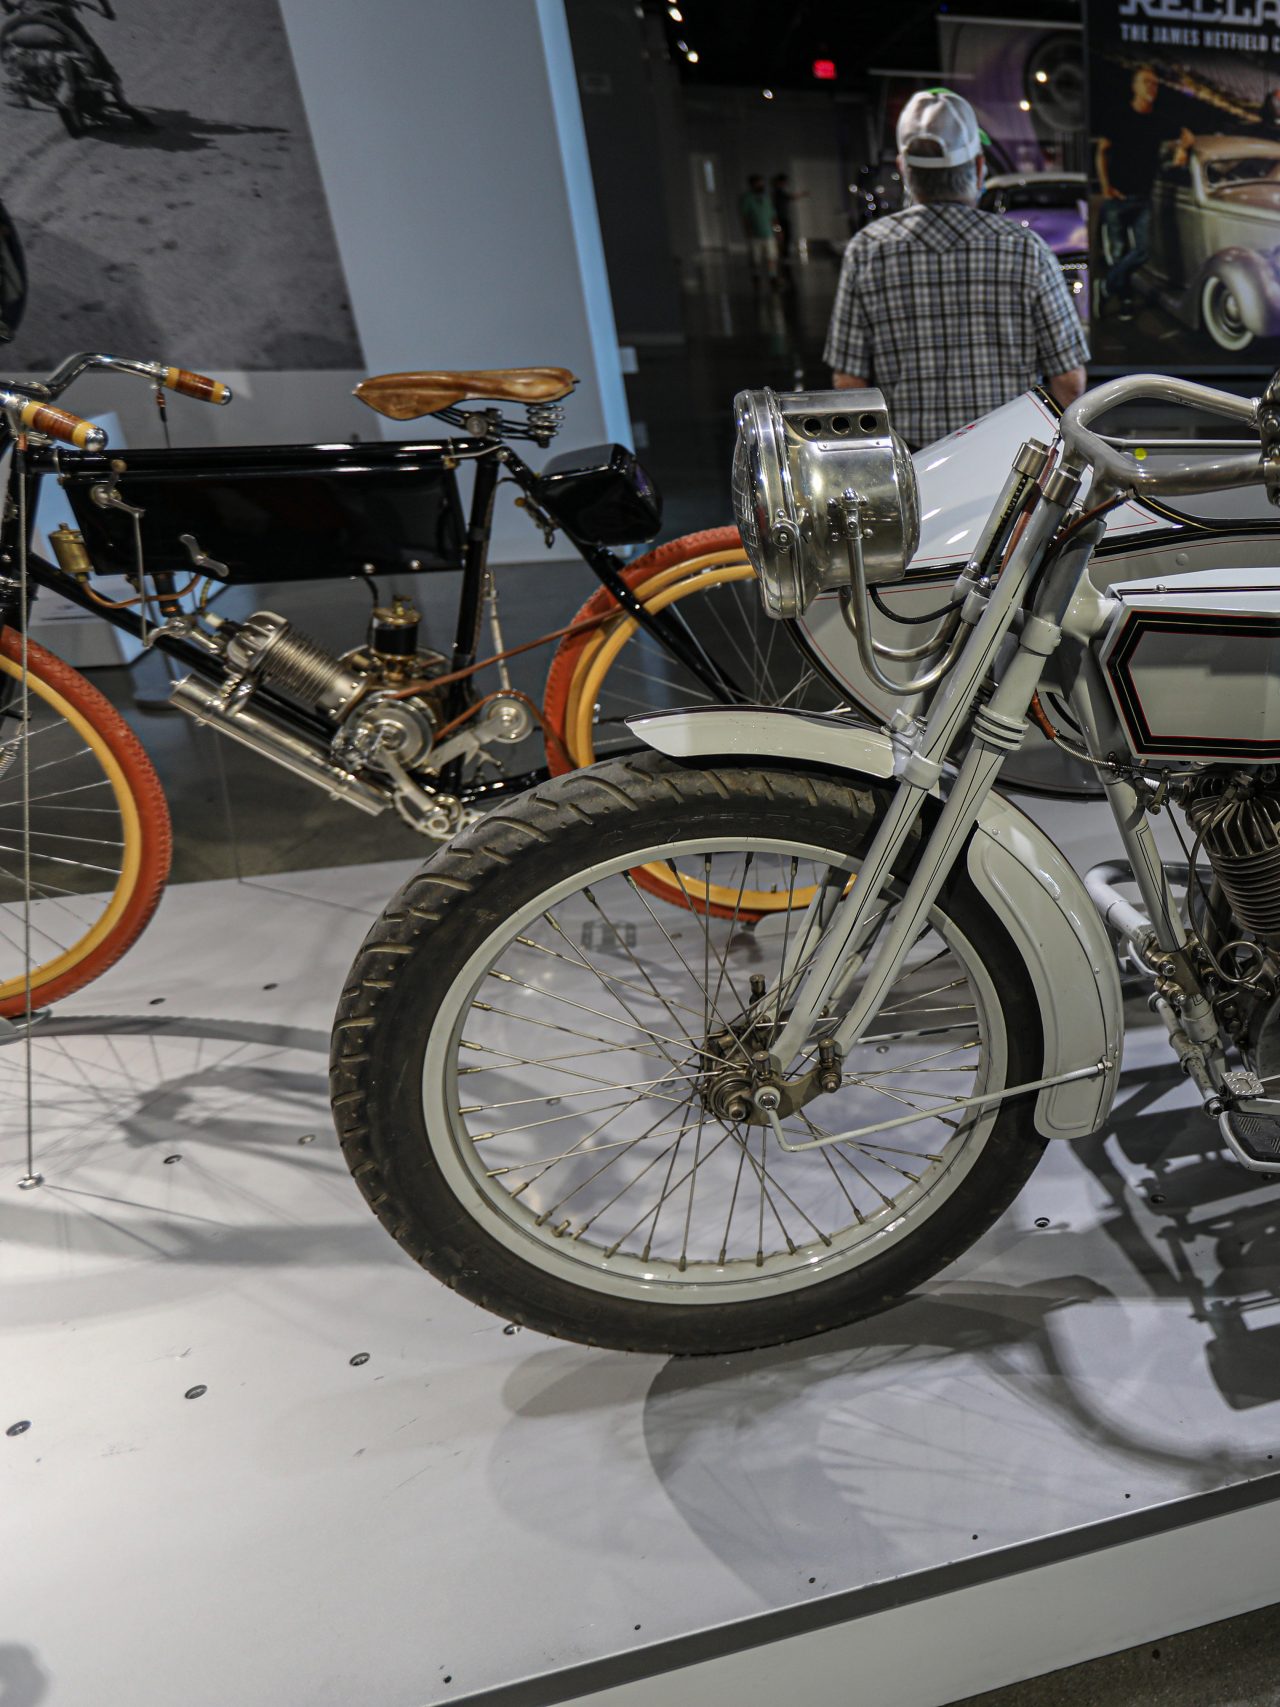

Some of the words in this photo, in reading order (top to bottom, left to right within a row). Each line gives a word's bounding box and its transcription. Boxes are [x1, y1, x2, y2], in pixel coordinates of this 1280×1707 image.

[1121, 24, 1149, 42] THE
[1153, 26, 1200, 46] JAMES
[1204, 29, 1268, 52] HETFIELD
